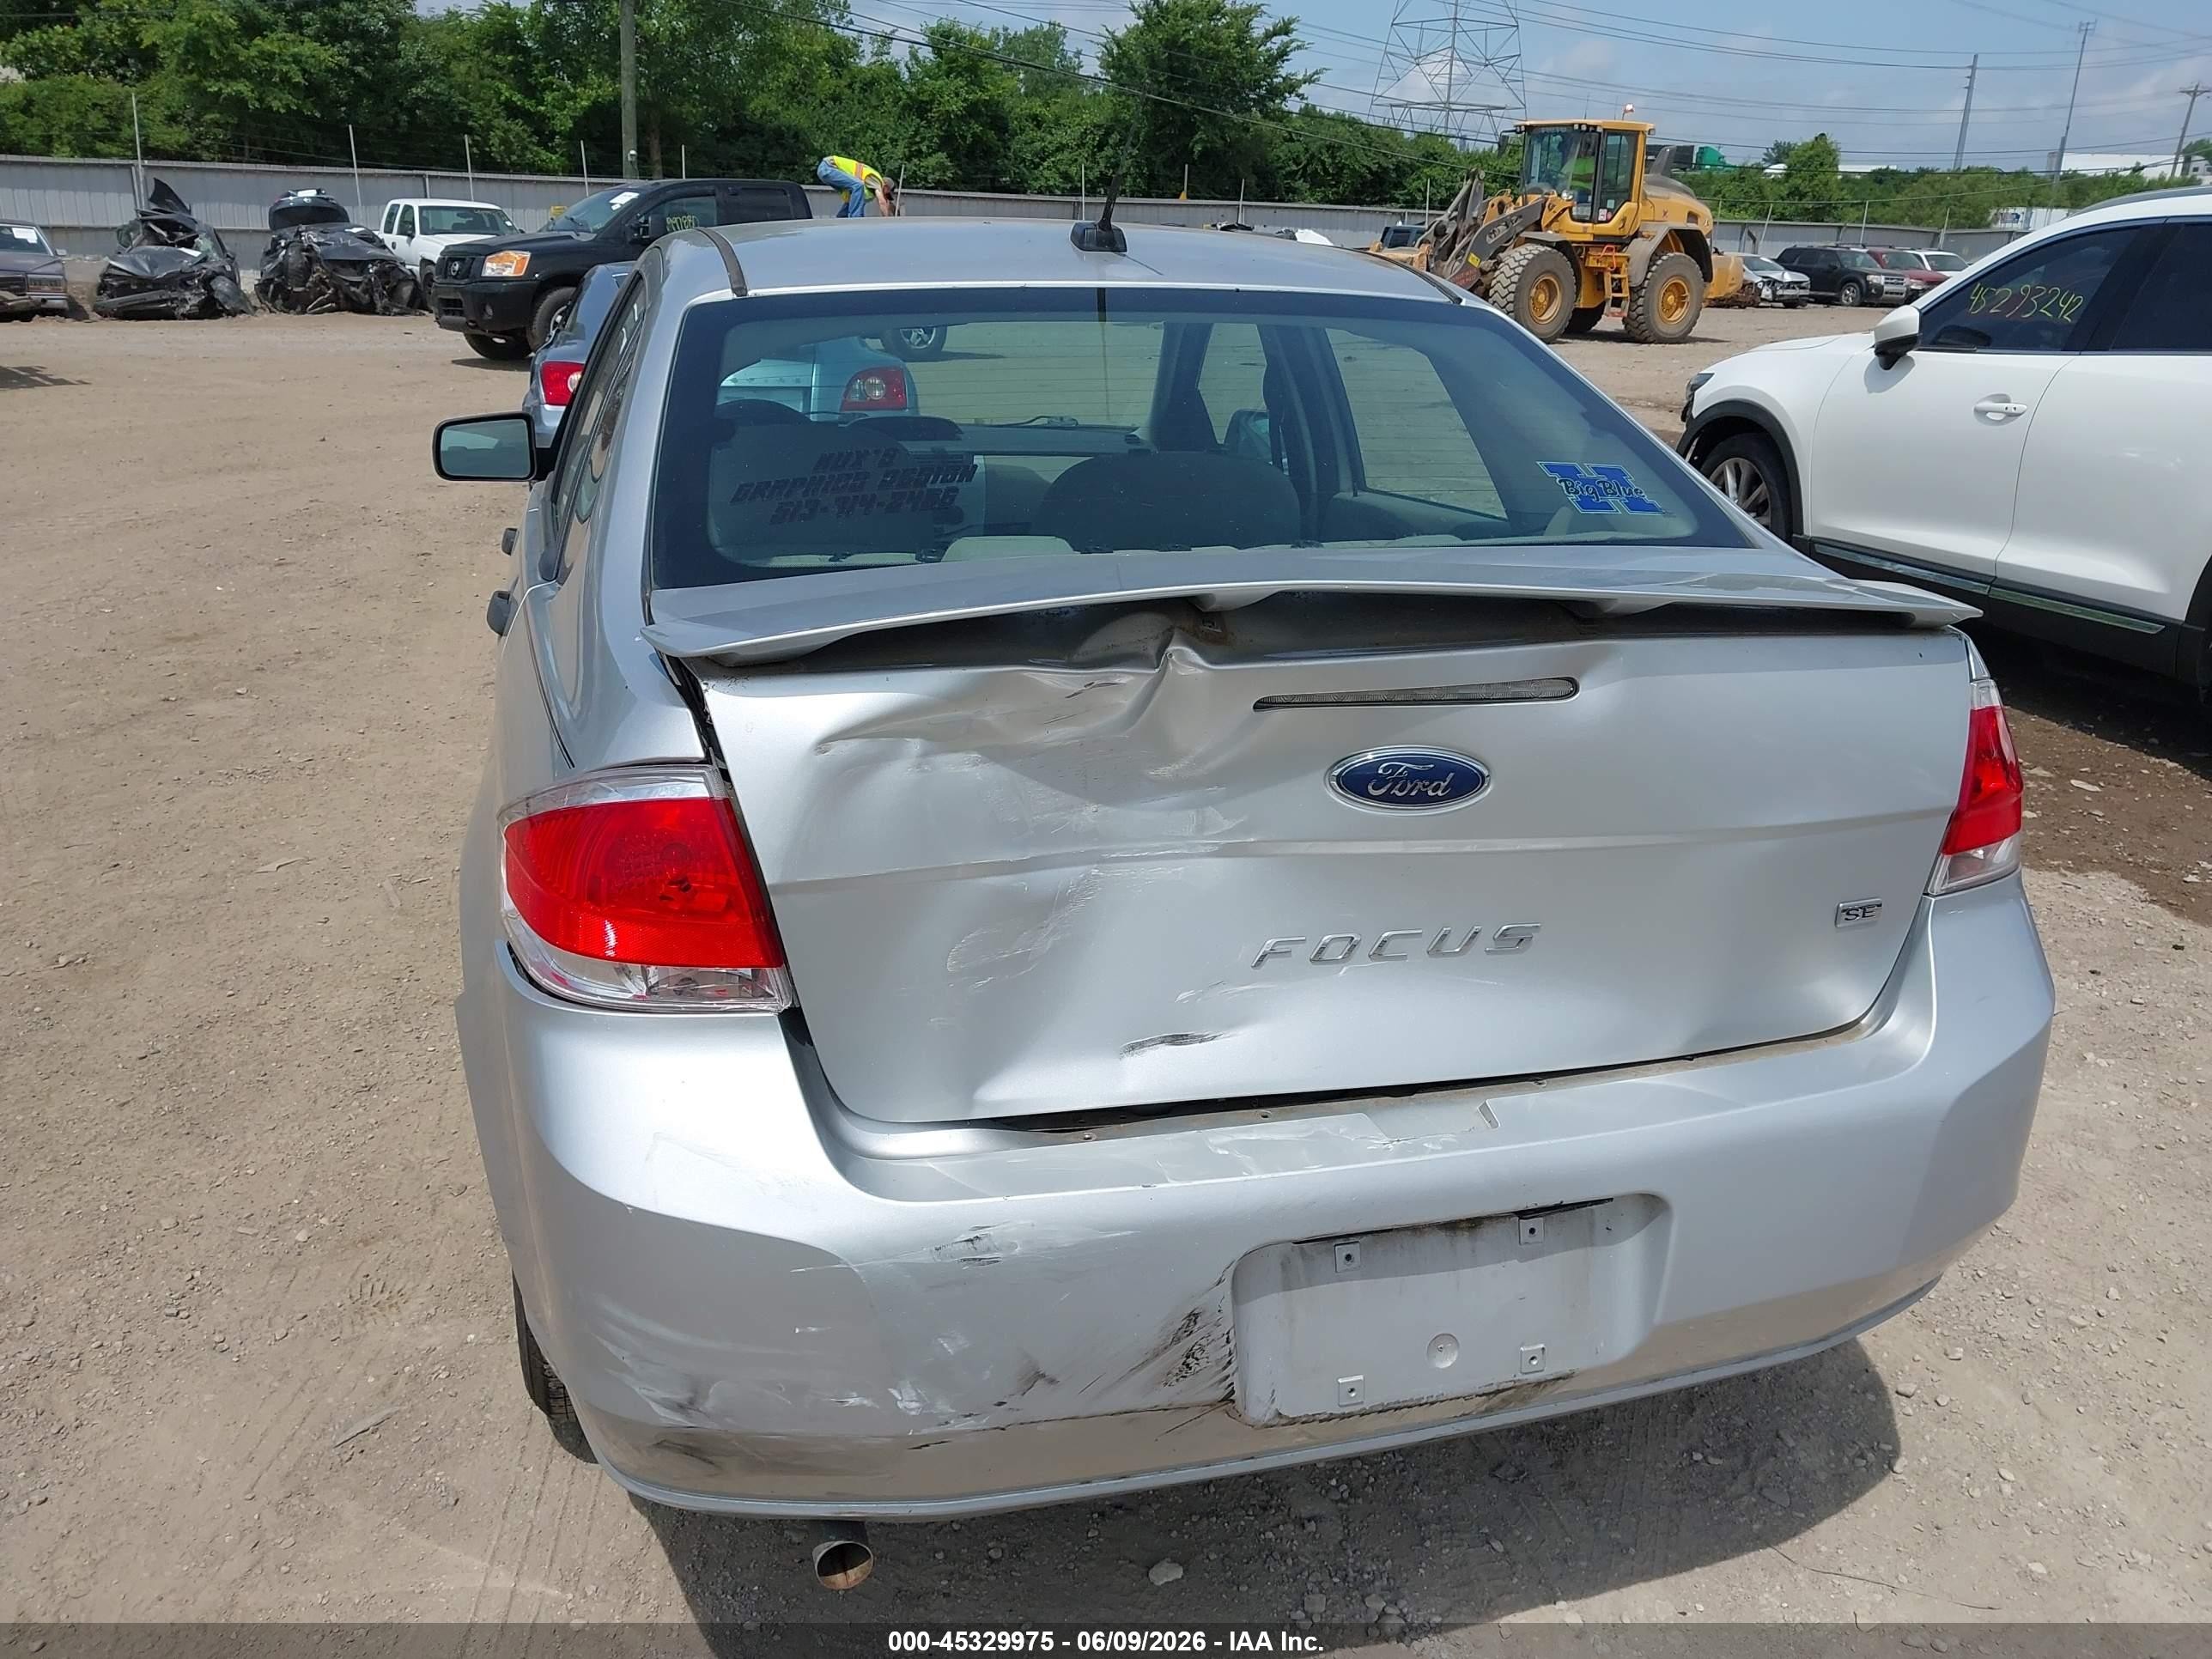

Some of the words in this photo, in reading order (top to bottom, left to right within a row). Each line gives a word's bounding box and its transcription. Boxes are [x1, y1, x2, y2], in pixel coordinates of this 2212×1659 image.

[1969, 283, 2084, 322] 45293242
[1557, 477, 1601, 502] Big
[1596, 478, 1646, 498] Blue
[1367, 762, 1455, 797] Ford
[1844, 906, 1876, 921] SE
[1250, 921, 1542, 969] FOCUS
